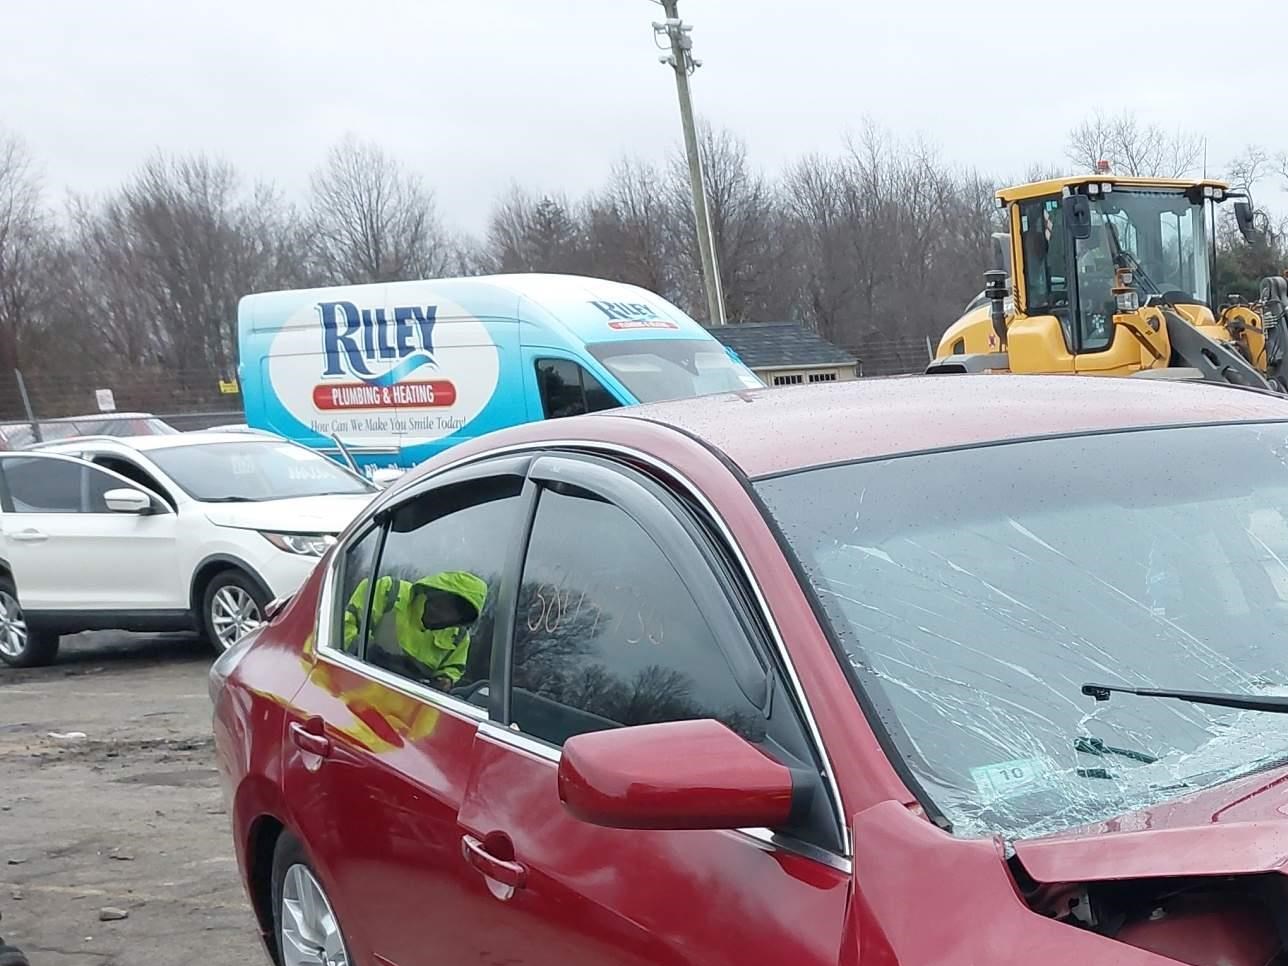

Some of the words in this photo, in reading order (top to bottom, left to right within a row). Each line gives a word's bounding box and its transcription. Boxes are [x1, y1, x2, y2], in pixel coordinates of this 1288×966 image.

[331, 386, 381, 406] PLUMBING
[383, 387, 392, 405] &
[393, 385, 434, 405] HEATING
[331, 419, 348, 433] Can
[350, 418, 363, 432] We
[365, 417, 388, 432] Make
[389, 417, 408, 432] You
[409, 416, 434, 431] Smile
[437, 415, 467, 432] Today!
